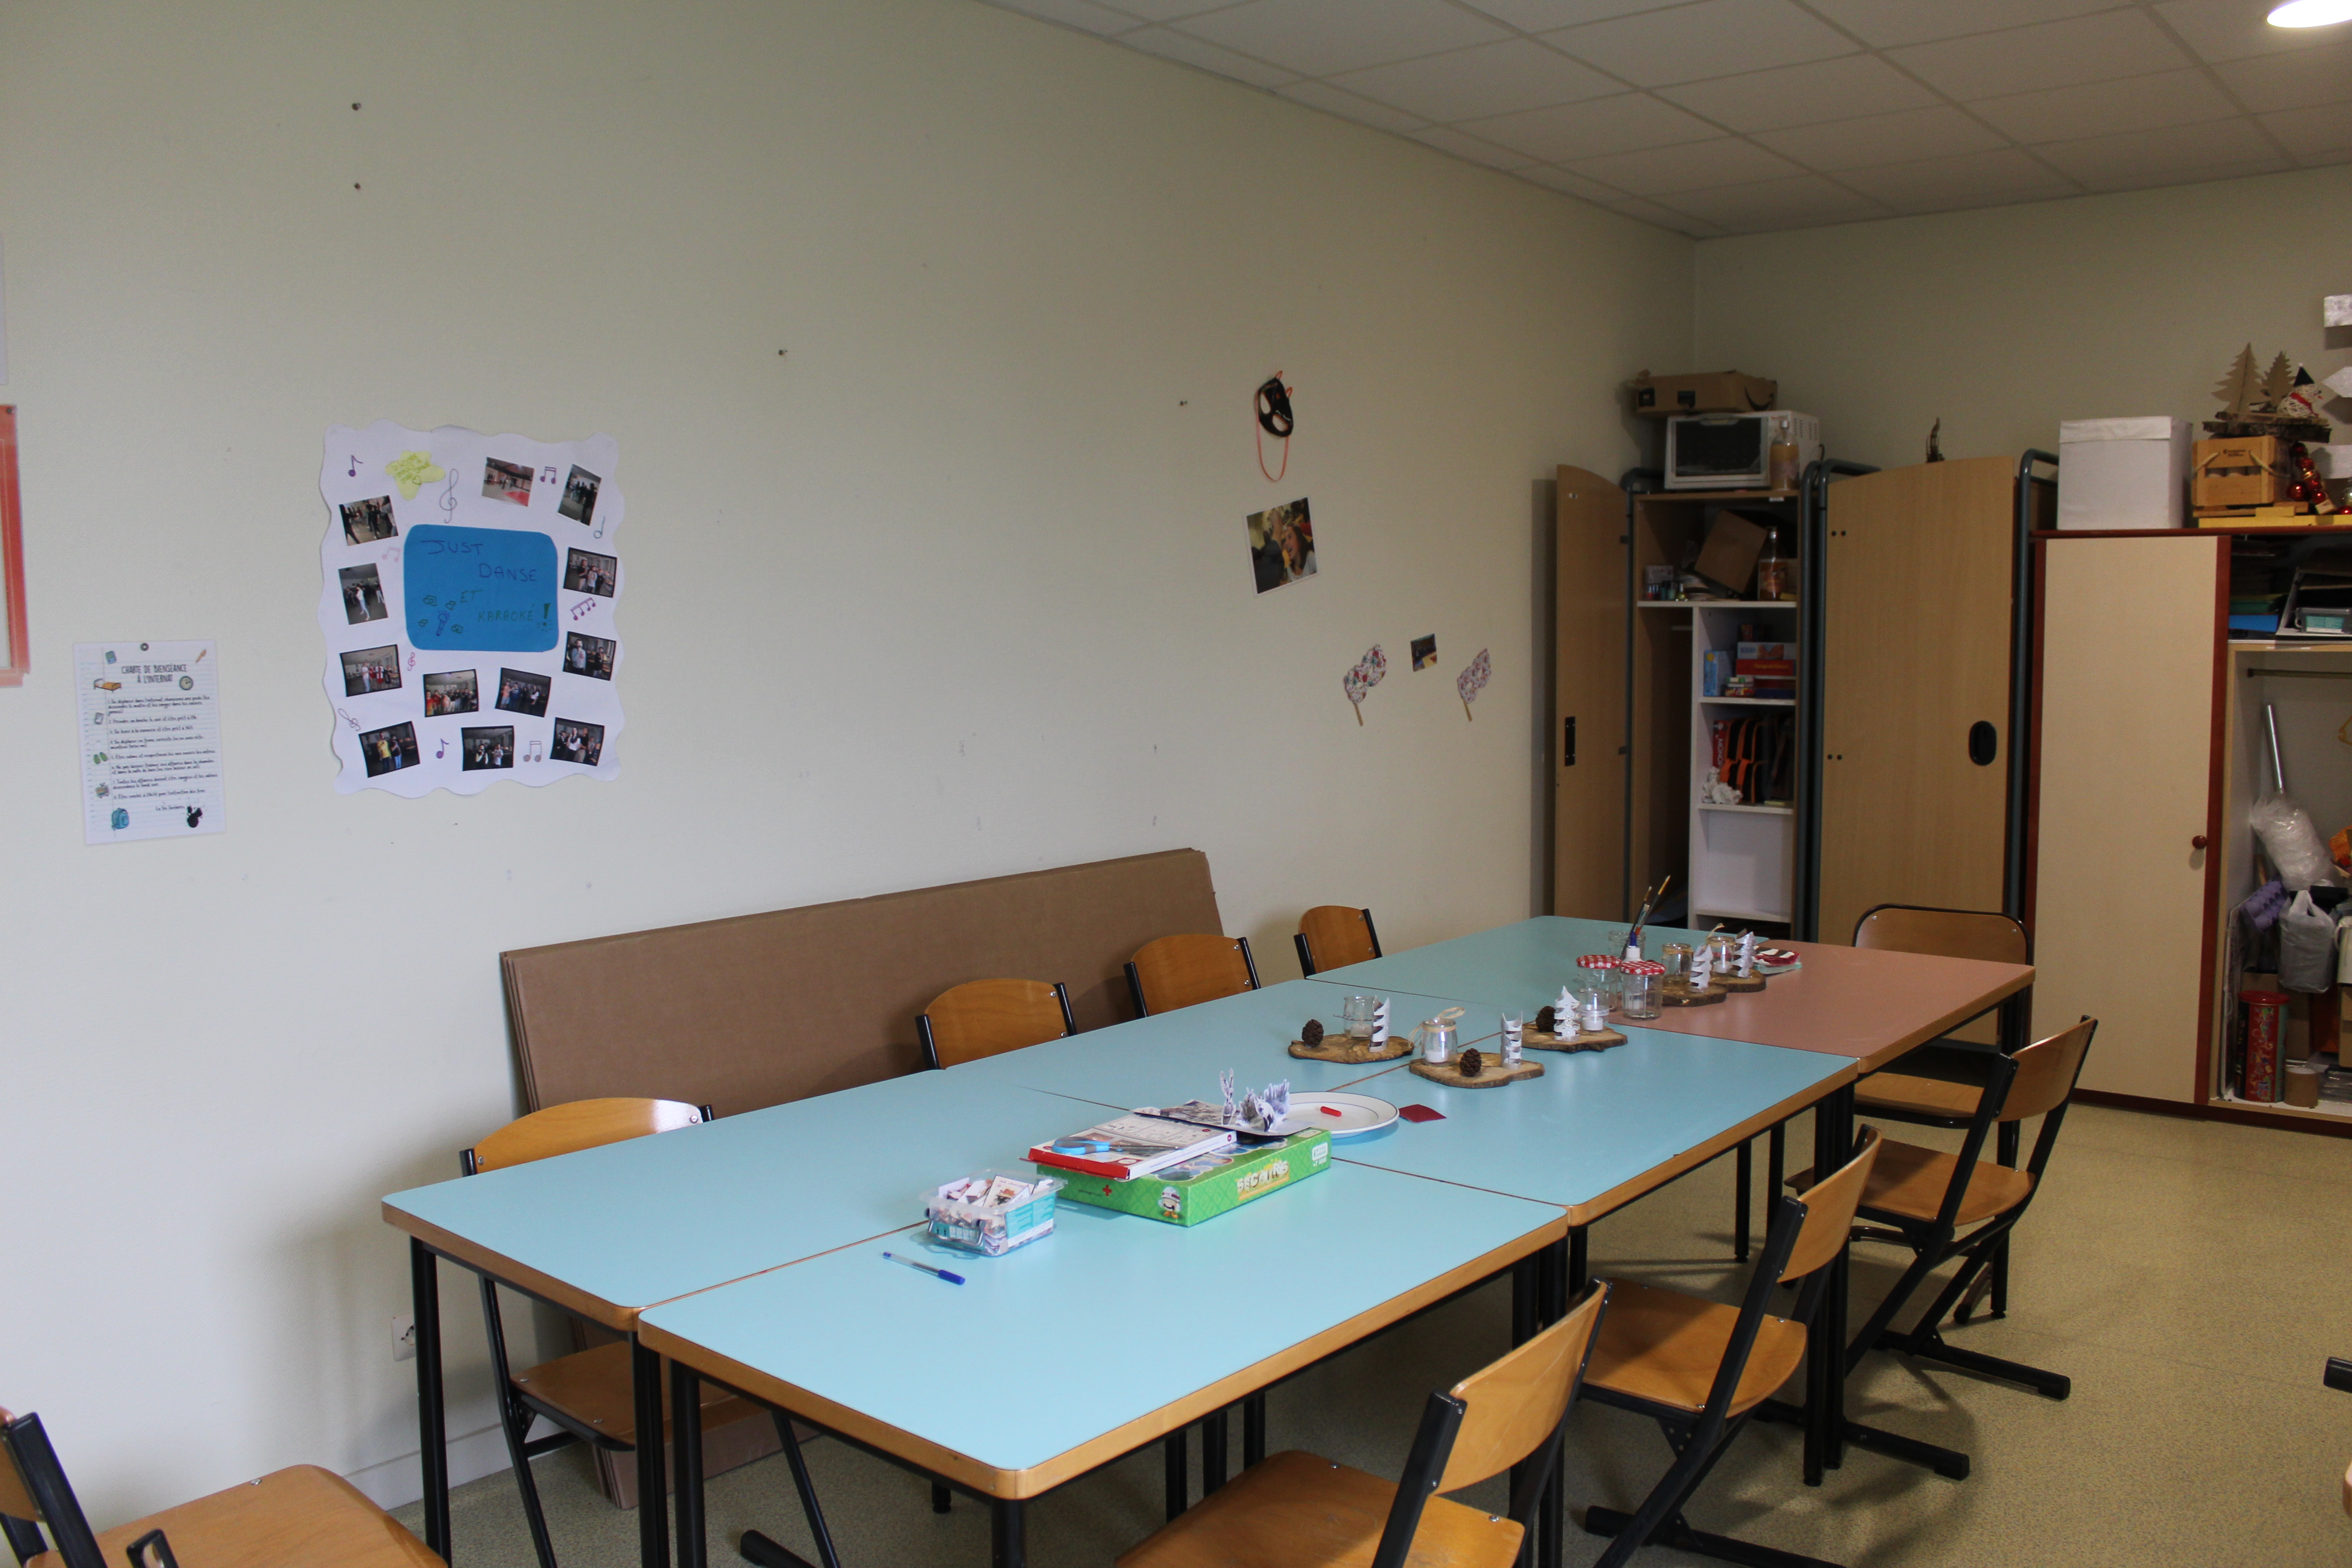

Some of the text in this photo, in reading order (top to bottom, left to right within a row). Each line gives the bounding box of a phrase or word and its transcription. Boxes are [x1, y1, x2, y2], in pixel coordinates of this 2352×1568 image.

[420, 540, 484, 555] JUST
[479, 563, 537, 582] DANSE
[461, 589, 484, 603] ET
